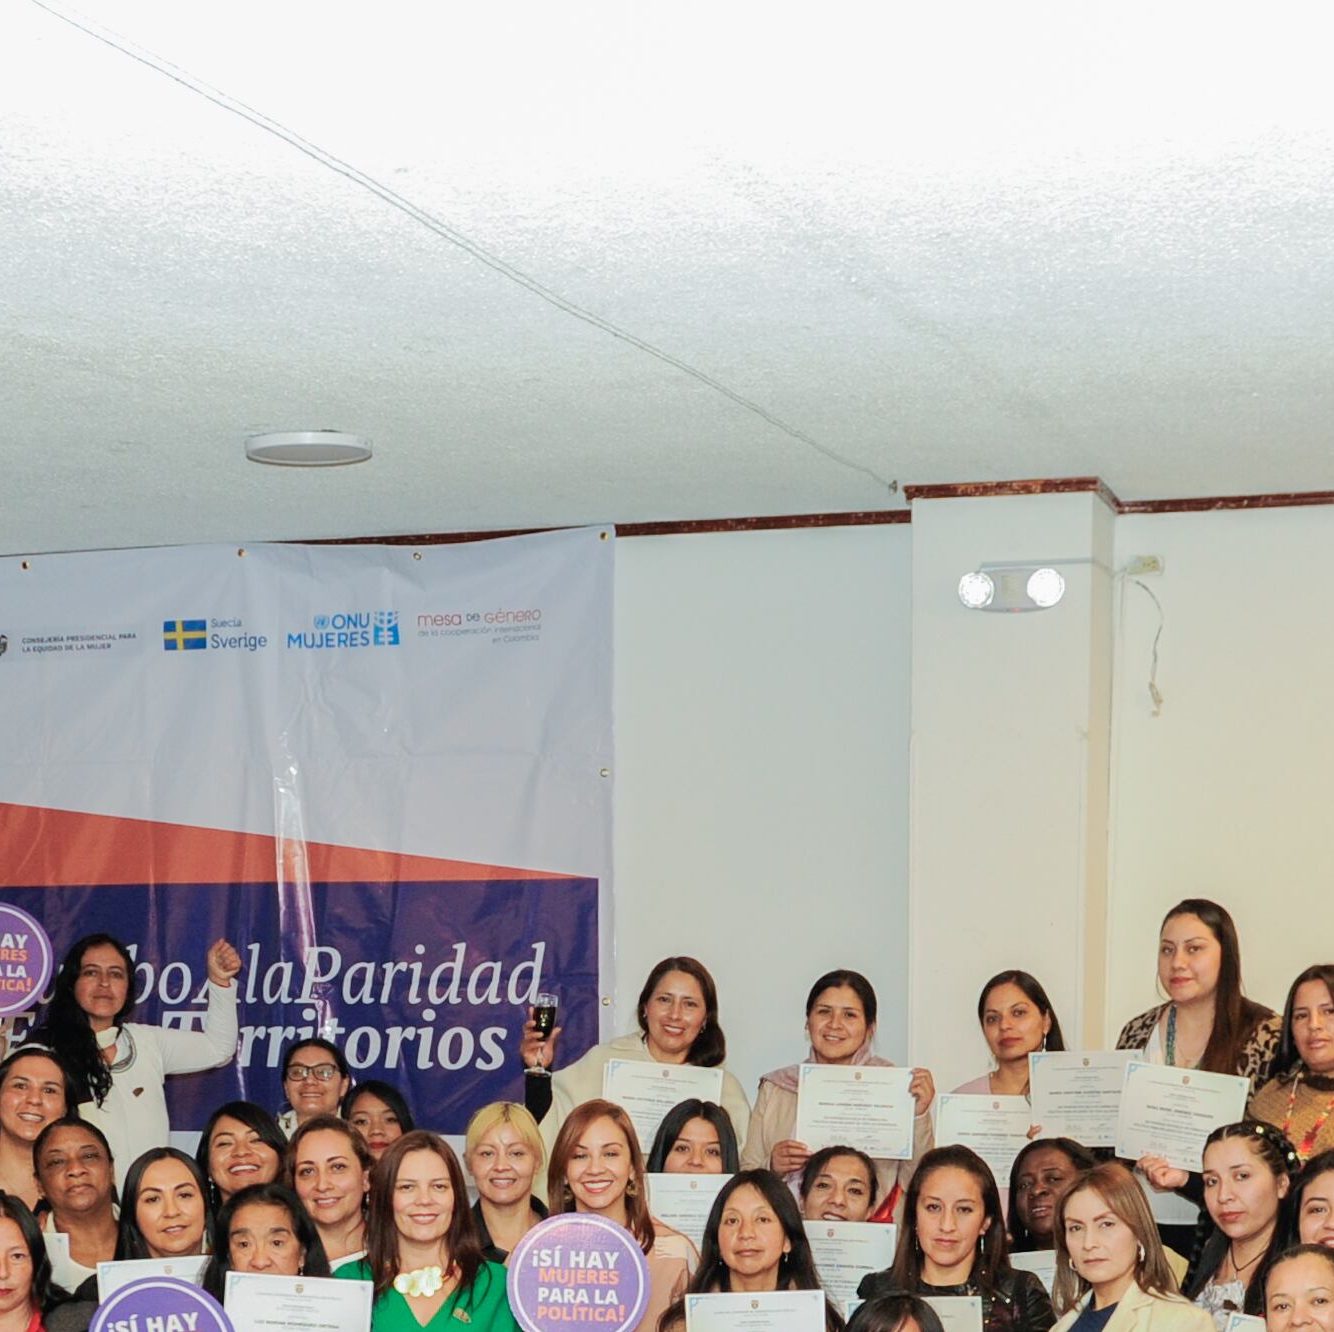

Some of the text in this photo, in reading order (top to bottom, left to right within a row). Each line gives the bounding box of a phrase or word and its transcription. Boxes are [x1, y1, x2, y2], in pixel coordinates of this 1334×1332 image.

[211, 618, 242, 628] Suecia
[332, 613, 370, 629] ONU
[418, 614, 461, 626] mesa
[67, 634, 116, 642] PRESIDENCIAL
[211, 634, 267, 651] Sverige
[287, 631, 370, 648] MUJERES
[6, 965, 26, 978] LA
[570, 1252, 619, 1269] HAY
[538, 1268, 619, 1287] MUJERES
[537, 1287, 619, 1305] PARA LA
[537, 1303, 626, 1322] POLÍTICA!
